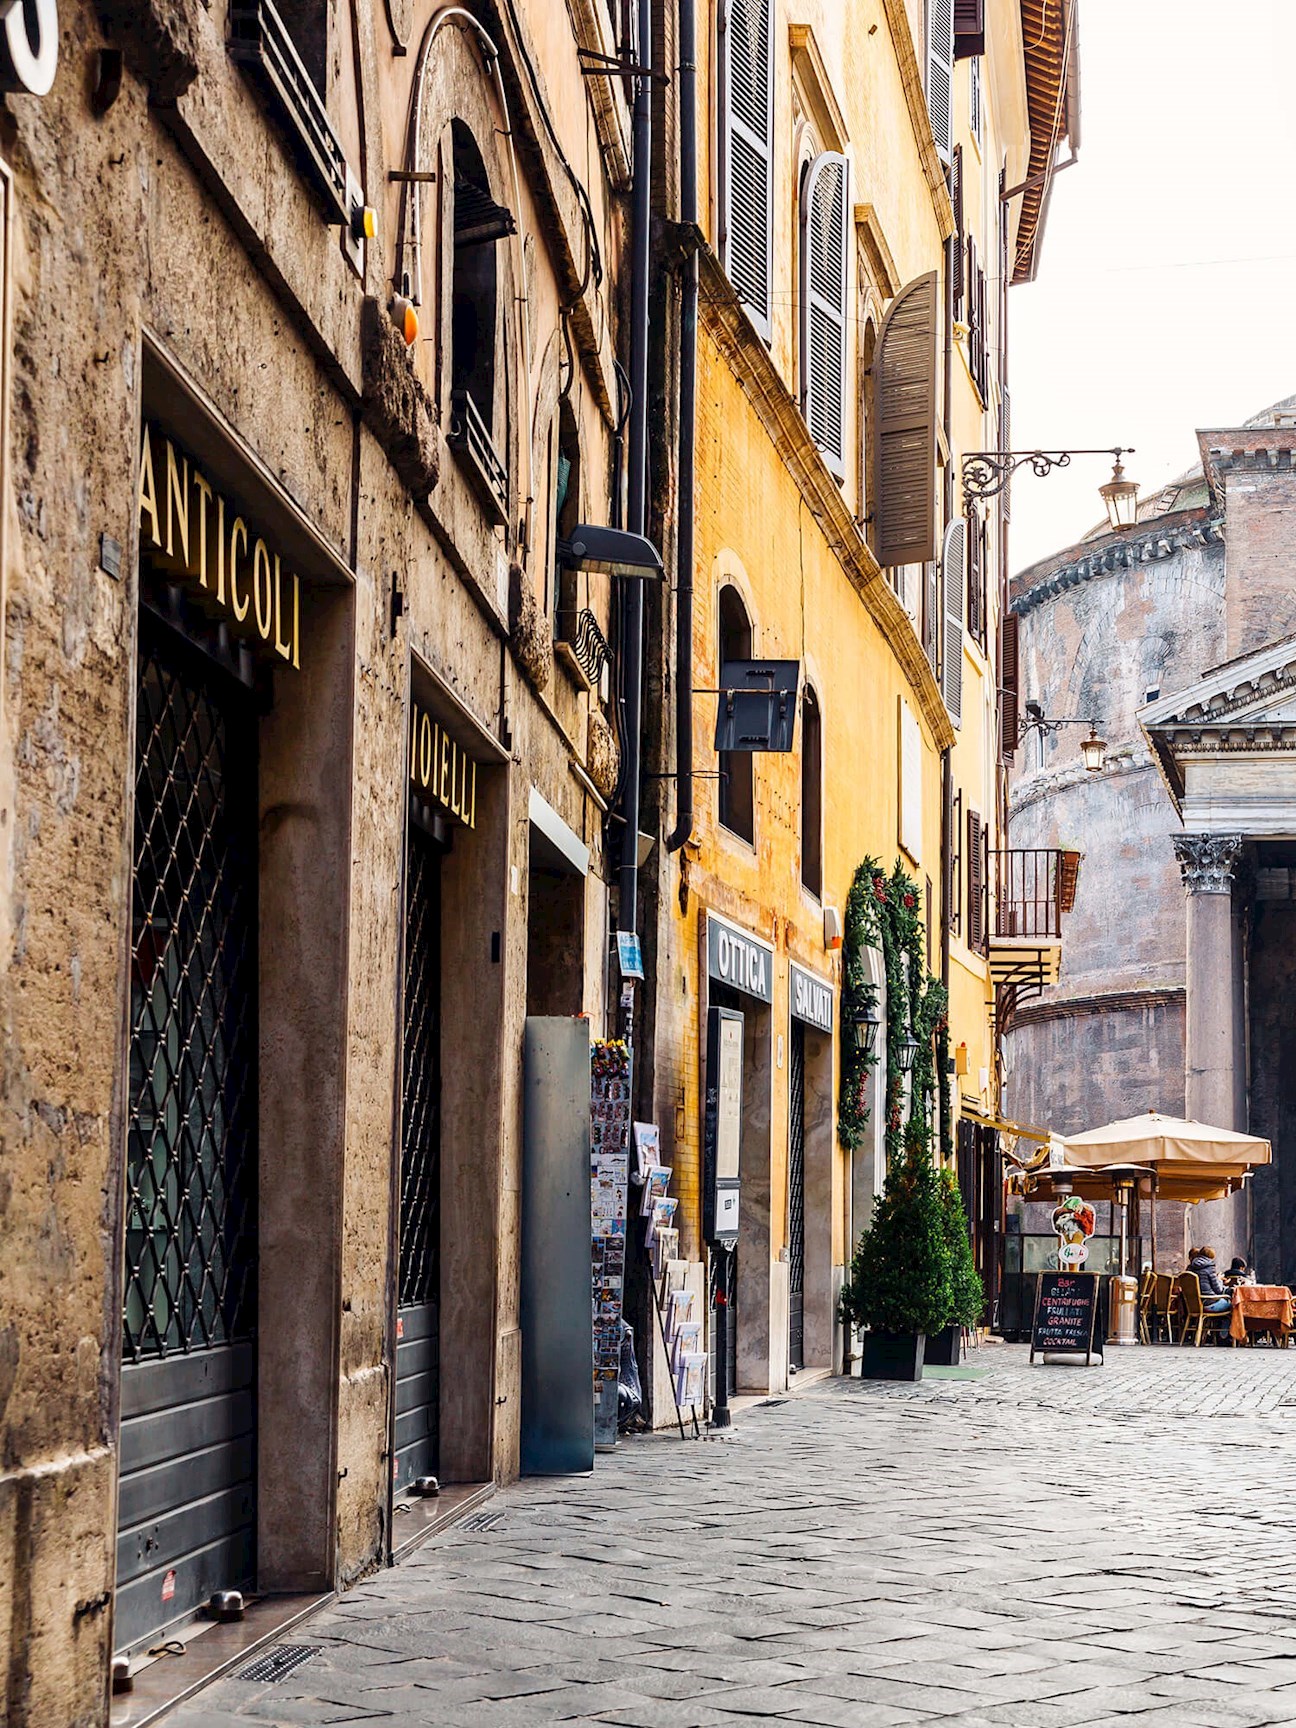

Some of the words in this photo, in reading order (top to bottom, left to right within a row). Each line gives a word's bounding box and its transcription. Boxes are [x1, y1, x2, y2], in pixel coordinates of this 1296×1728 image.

[138, 422, 300, 670] ANTICOLI
[718, 929, 766, 996] OTTICA
[795, 973, 831, 1028] SALVATI
[1042, 1297, 1090, 1306] CENTRIFUGHE
[1047, 1316, 1083, 1326] GRANITE
[1038, 1327, 1062, 1336] FRUTTA
[1043, 1337, 1077, 1346] COCKTAIL
